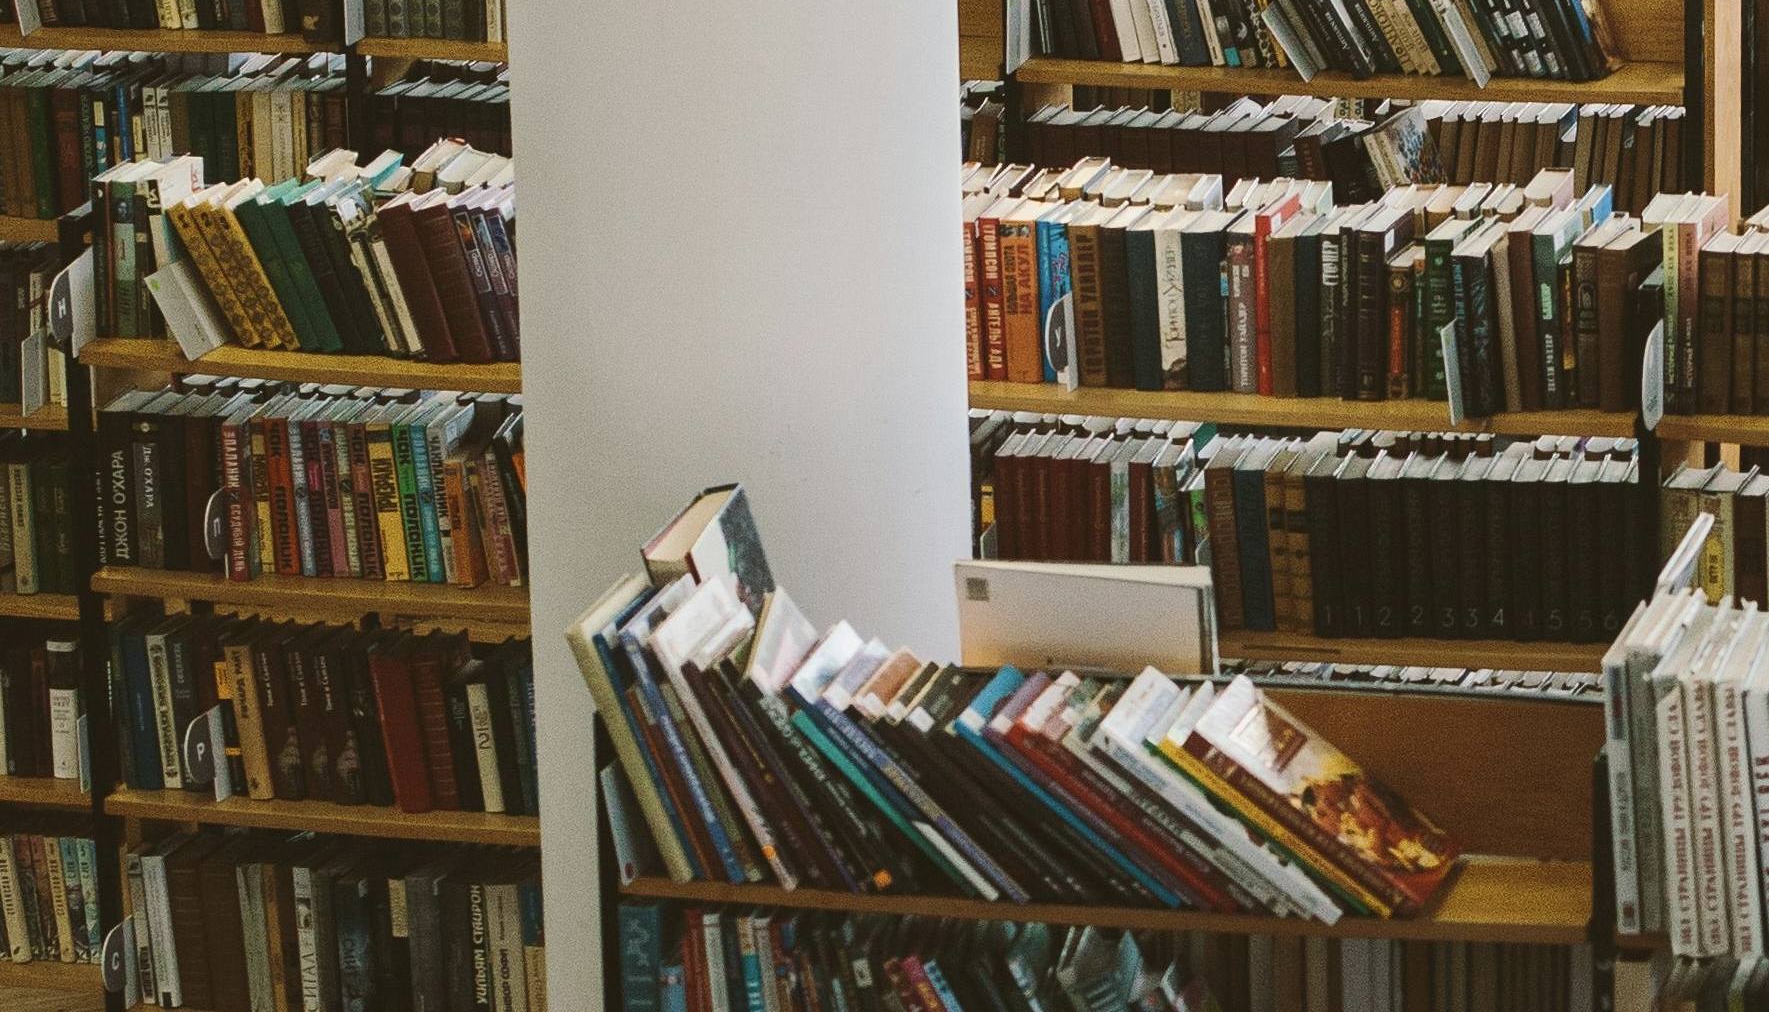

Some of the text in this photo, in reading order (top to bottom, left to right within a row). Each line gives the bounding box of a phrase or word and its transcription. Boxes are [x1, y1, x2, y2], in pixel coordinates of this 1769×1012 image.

[983, 228, 998, 279] ТОМПСОН
[1004, 245, 1018, 315] БОЛЬШАЯ ОХОТА
[1017, 245, 1032, 315] НА АКУЛ
[987, 302, 1003, 369] АНГЕЛЫ АДА
[224, 439, 240, 488] ПАЛАНИК
[111, 449, 130, 560] ДЖОН О'ХАРА
[229, 503, 245, 572] ССУДНЫЙ ДЕНЬ
[1379, 606, 1390, 626] 2
[1412, 605, 1423, 624] 2
[1443, 608, 1455, 627] 3
[1466, 608, 1478, 627] 3
[1492, 605, 1504, 626] 4
[1525, 608, 1534, 627] 4
[1549, 609, 1562, 630] 5
[1580, 610, 1592, 630] 5
[1604, 609, 1617, 630] 6
[1668, 704, 1679, 735] СЛА
[195, 742, 206, 762] Р
[1674, 828, 1690, 912] СТРАНИЦЫ
[1702, 828, 1718, 912] СТРАНИЦЫ
[1734, 834, 1749, 919] СТРАНИЦЫ
[112, 951, 120, 970] С
[473, 949, 488, 1004] УИЛЬЯМ
